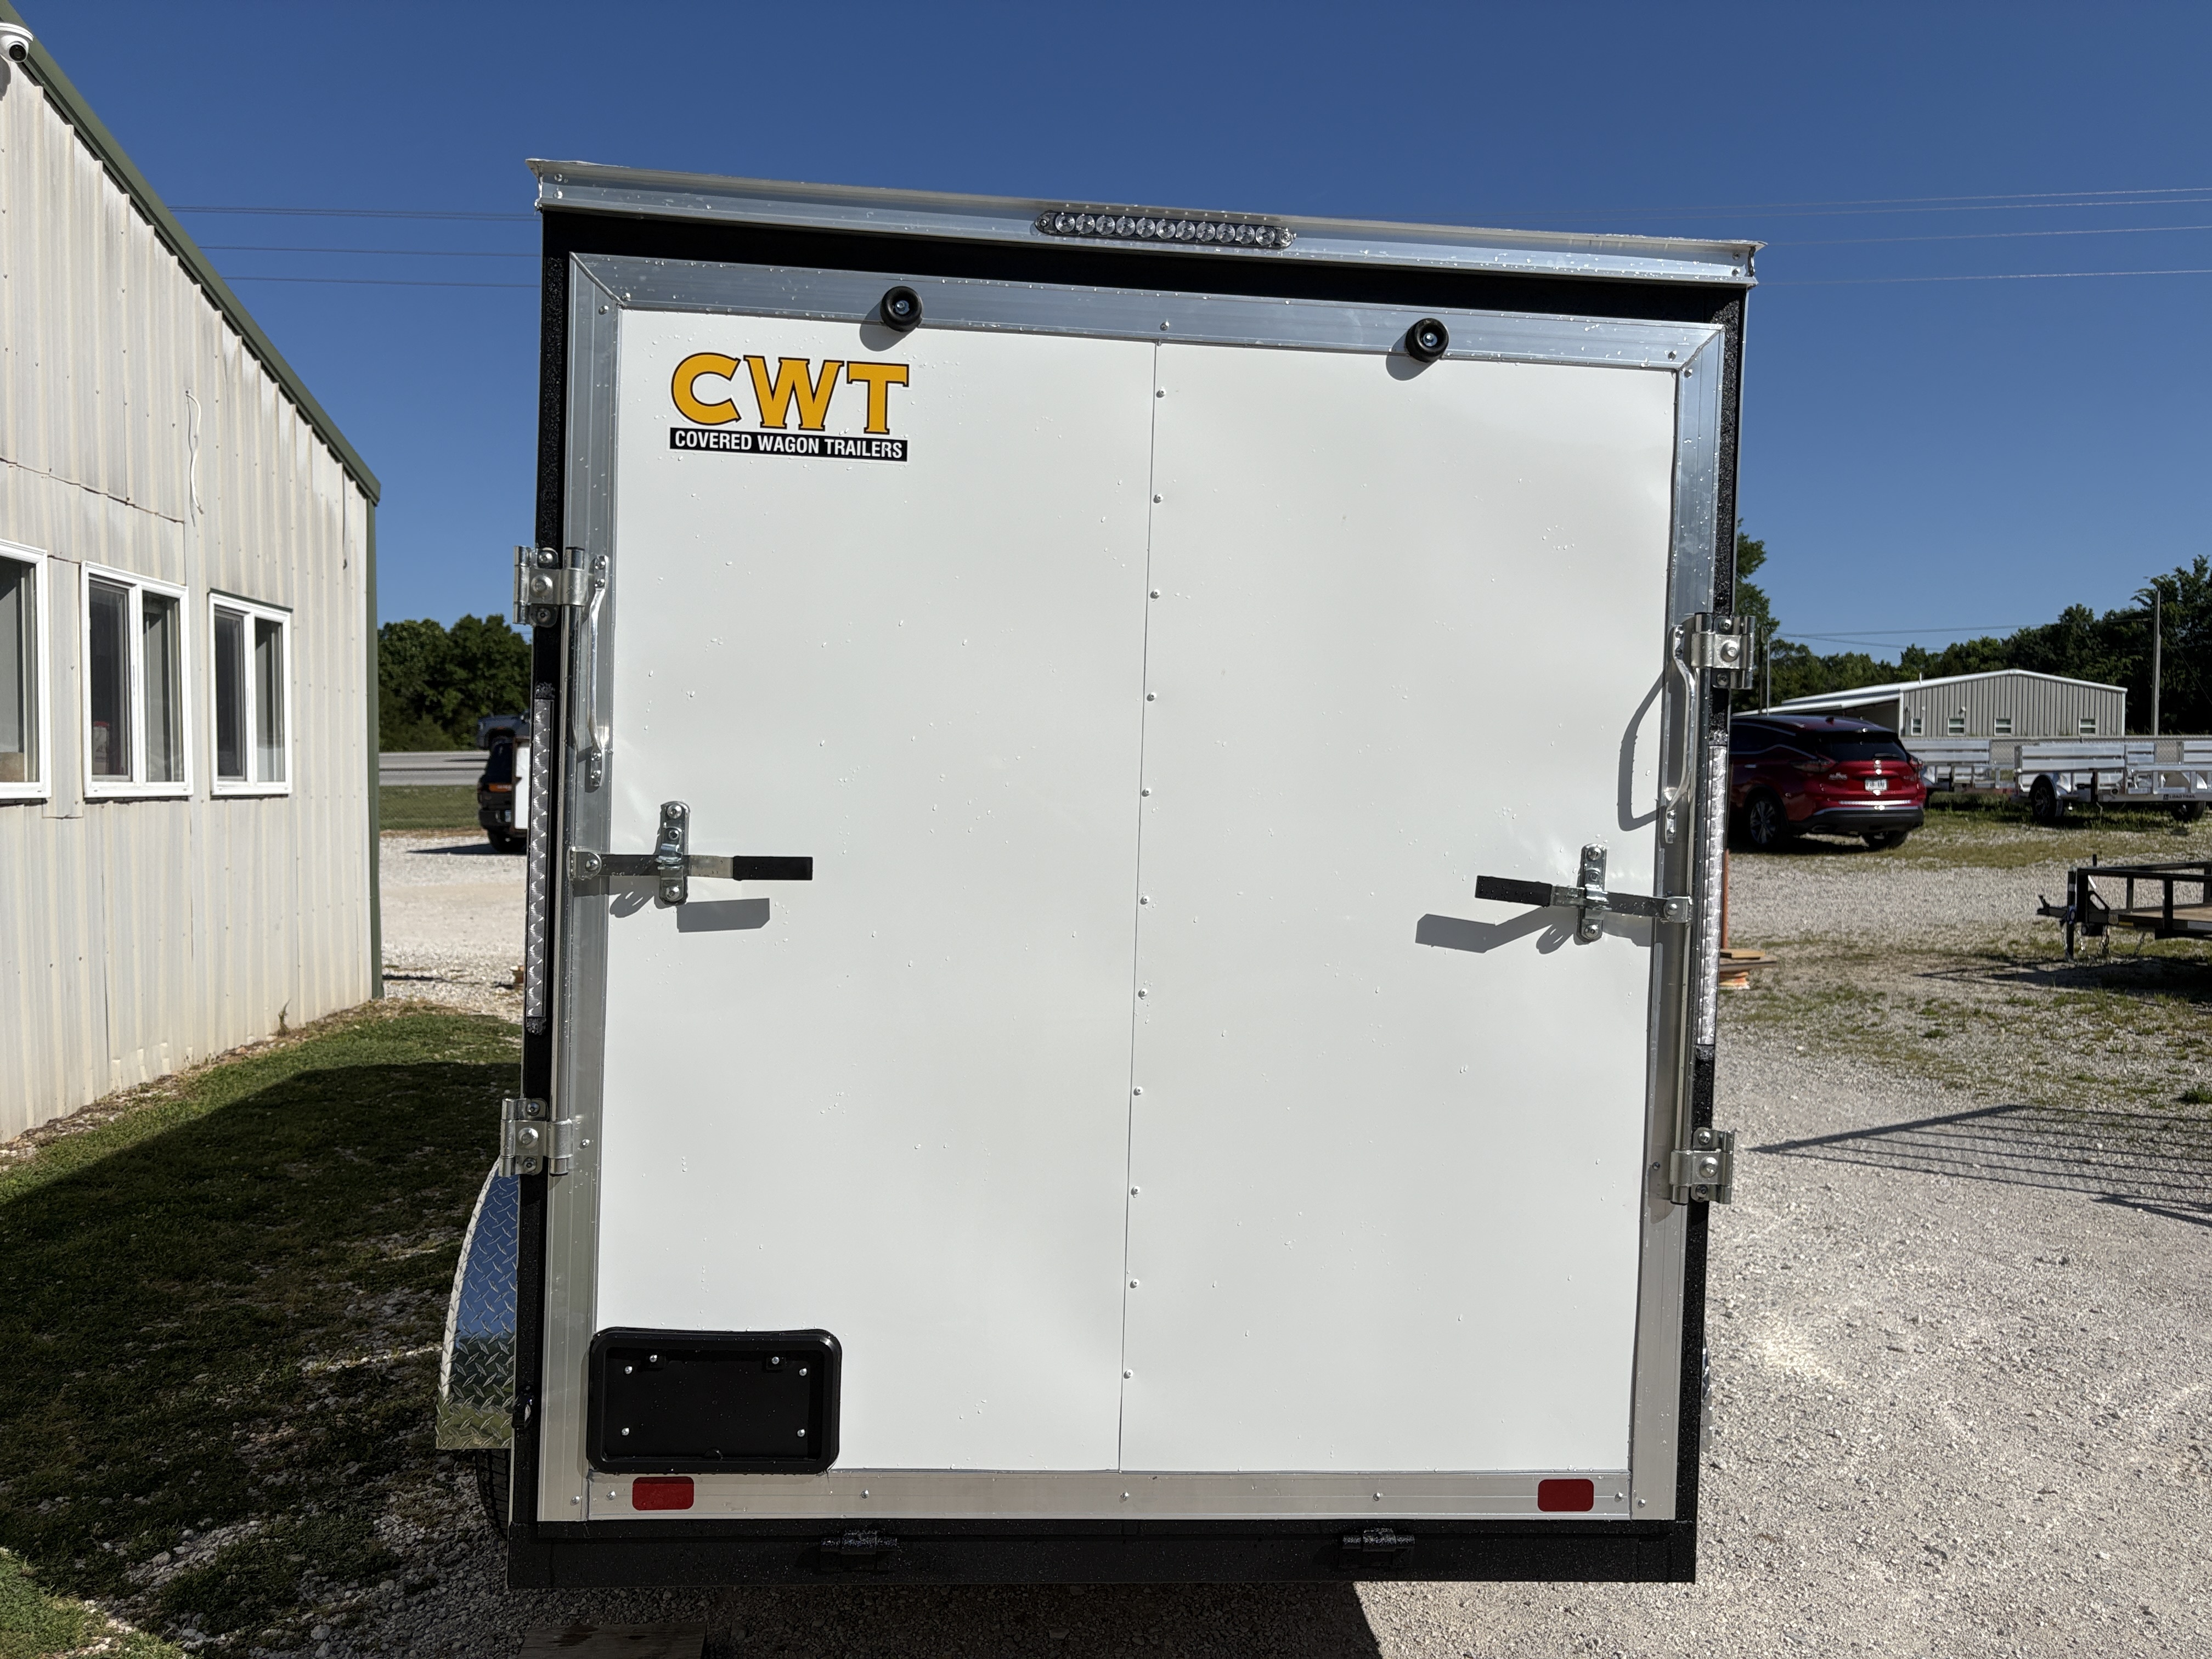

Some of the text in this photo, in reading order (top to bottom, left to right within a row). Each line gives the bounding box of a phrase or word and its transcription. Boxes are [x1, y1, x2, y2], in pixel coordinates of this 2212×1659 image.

[672, 352, 909, 435] CWT
[675, 431, 902, 459] COVERED WAGON TRAILERS
